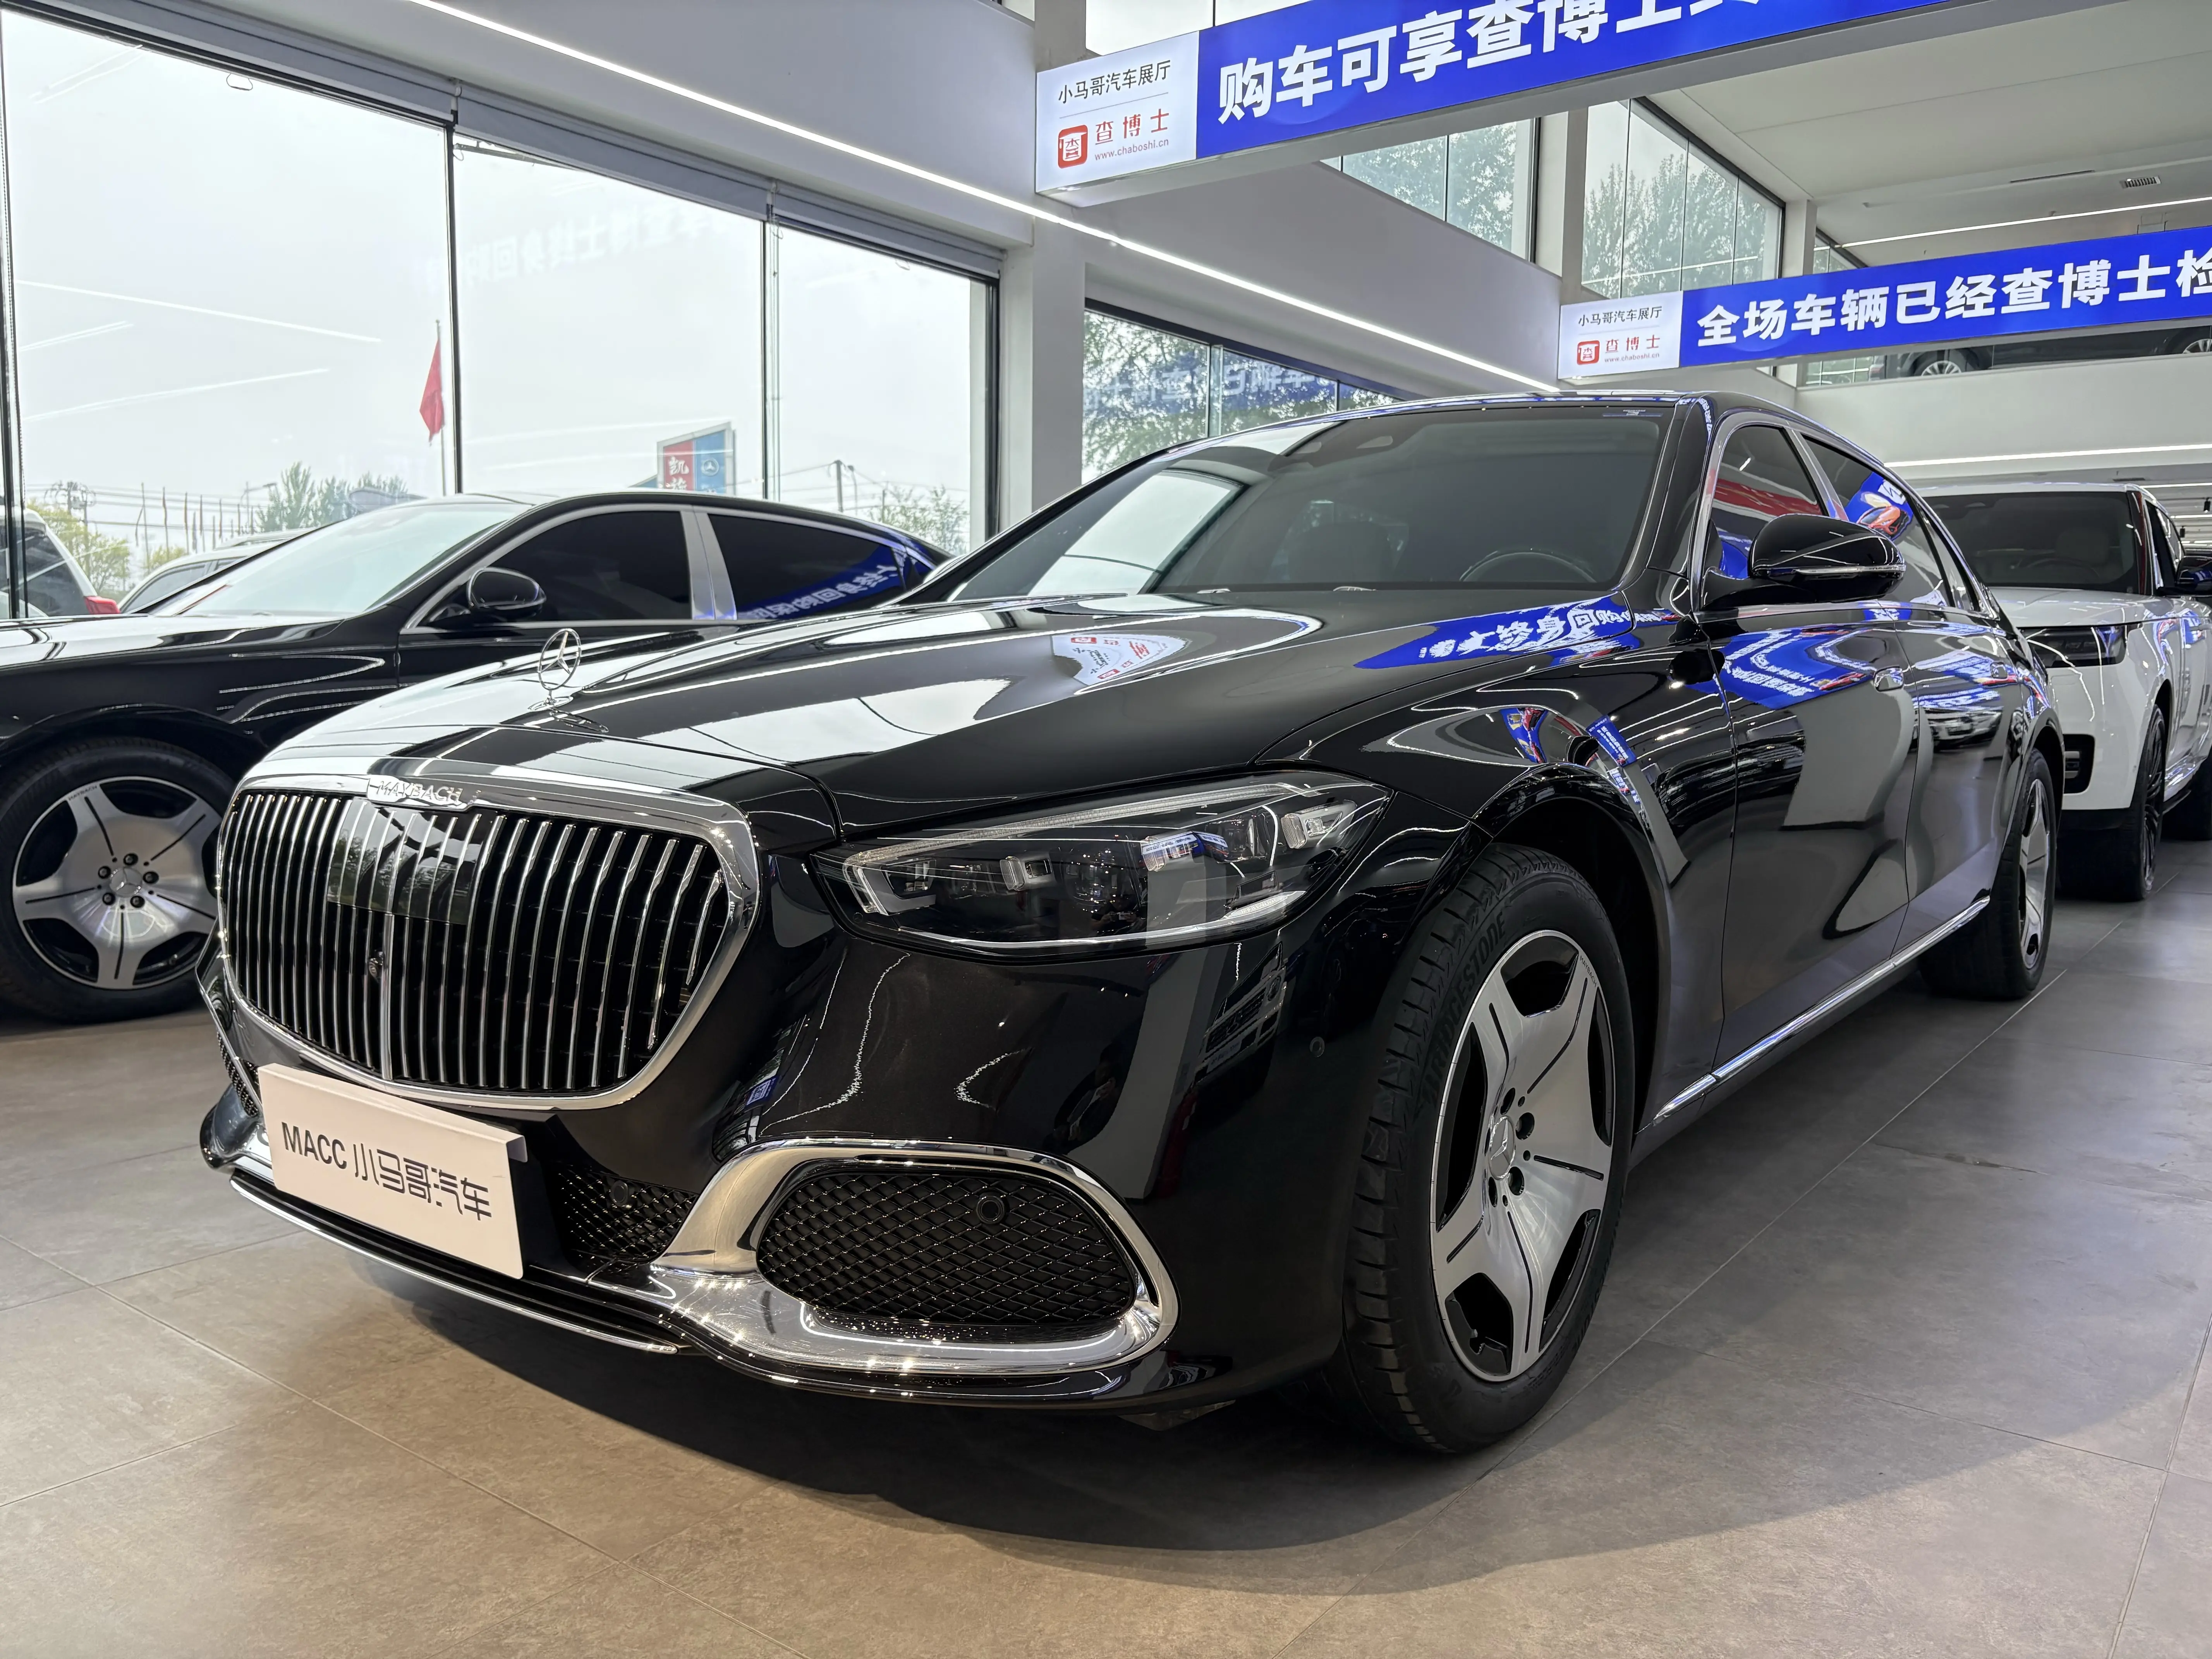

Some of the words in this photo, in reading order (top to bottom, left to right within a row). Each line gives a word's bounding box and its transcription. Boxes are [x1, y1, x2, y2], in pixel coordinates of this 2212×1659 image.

[1218, 0, 1759, 124] 购车可享查博
[1058, 60, 1171, 104] 小马哥汽车展厅
[1095, 108, 1169, 145] 查博士
[1095, 138, 1169, 161] www.chaboshi.cn
[1697, 247, 2212, 347] 全场车辆已经查博士检
[1578, 306, 1662, 326] 小马哥汽车展厅
[1604, 352, 1660, 363] www.chaboshi.cn
[1605, 334, 1660, 354] 查博士
[376, 780, 464, 805] MAYBACH
[1579, 955, 1597, 987] MAYBACH
[1421, 911, 1506, 1104] BRIDGESTONE
[281, 1122, 347, 1170] MACC
[353, 1142, 493, 1221] 小马哥汽车
